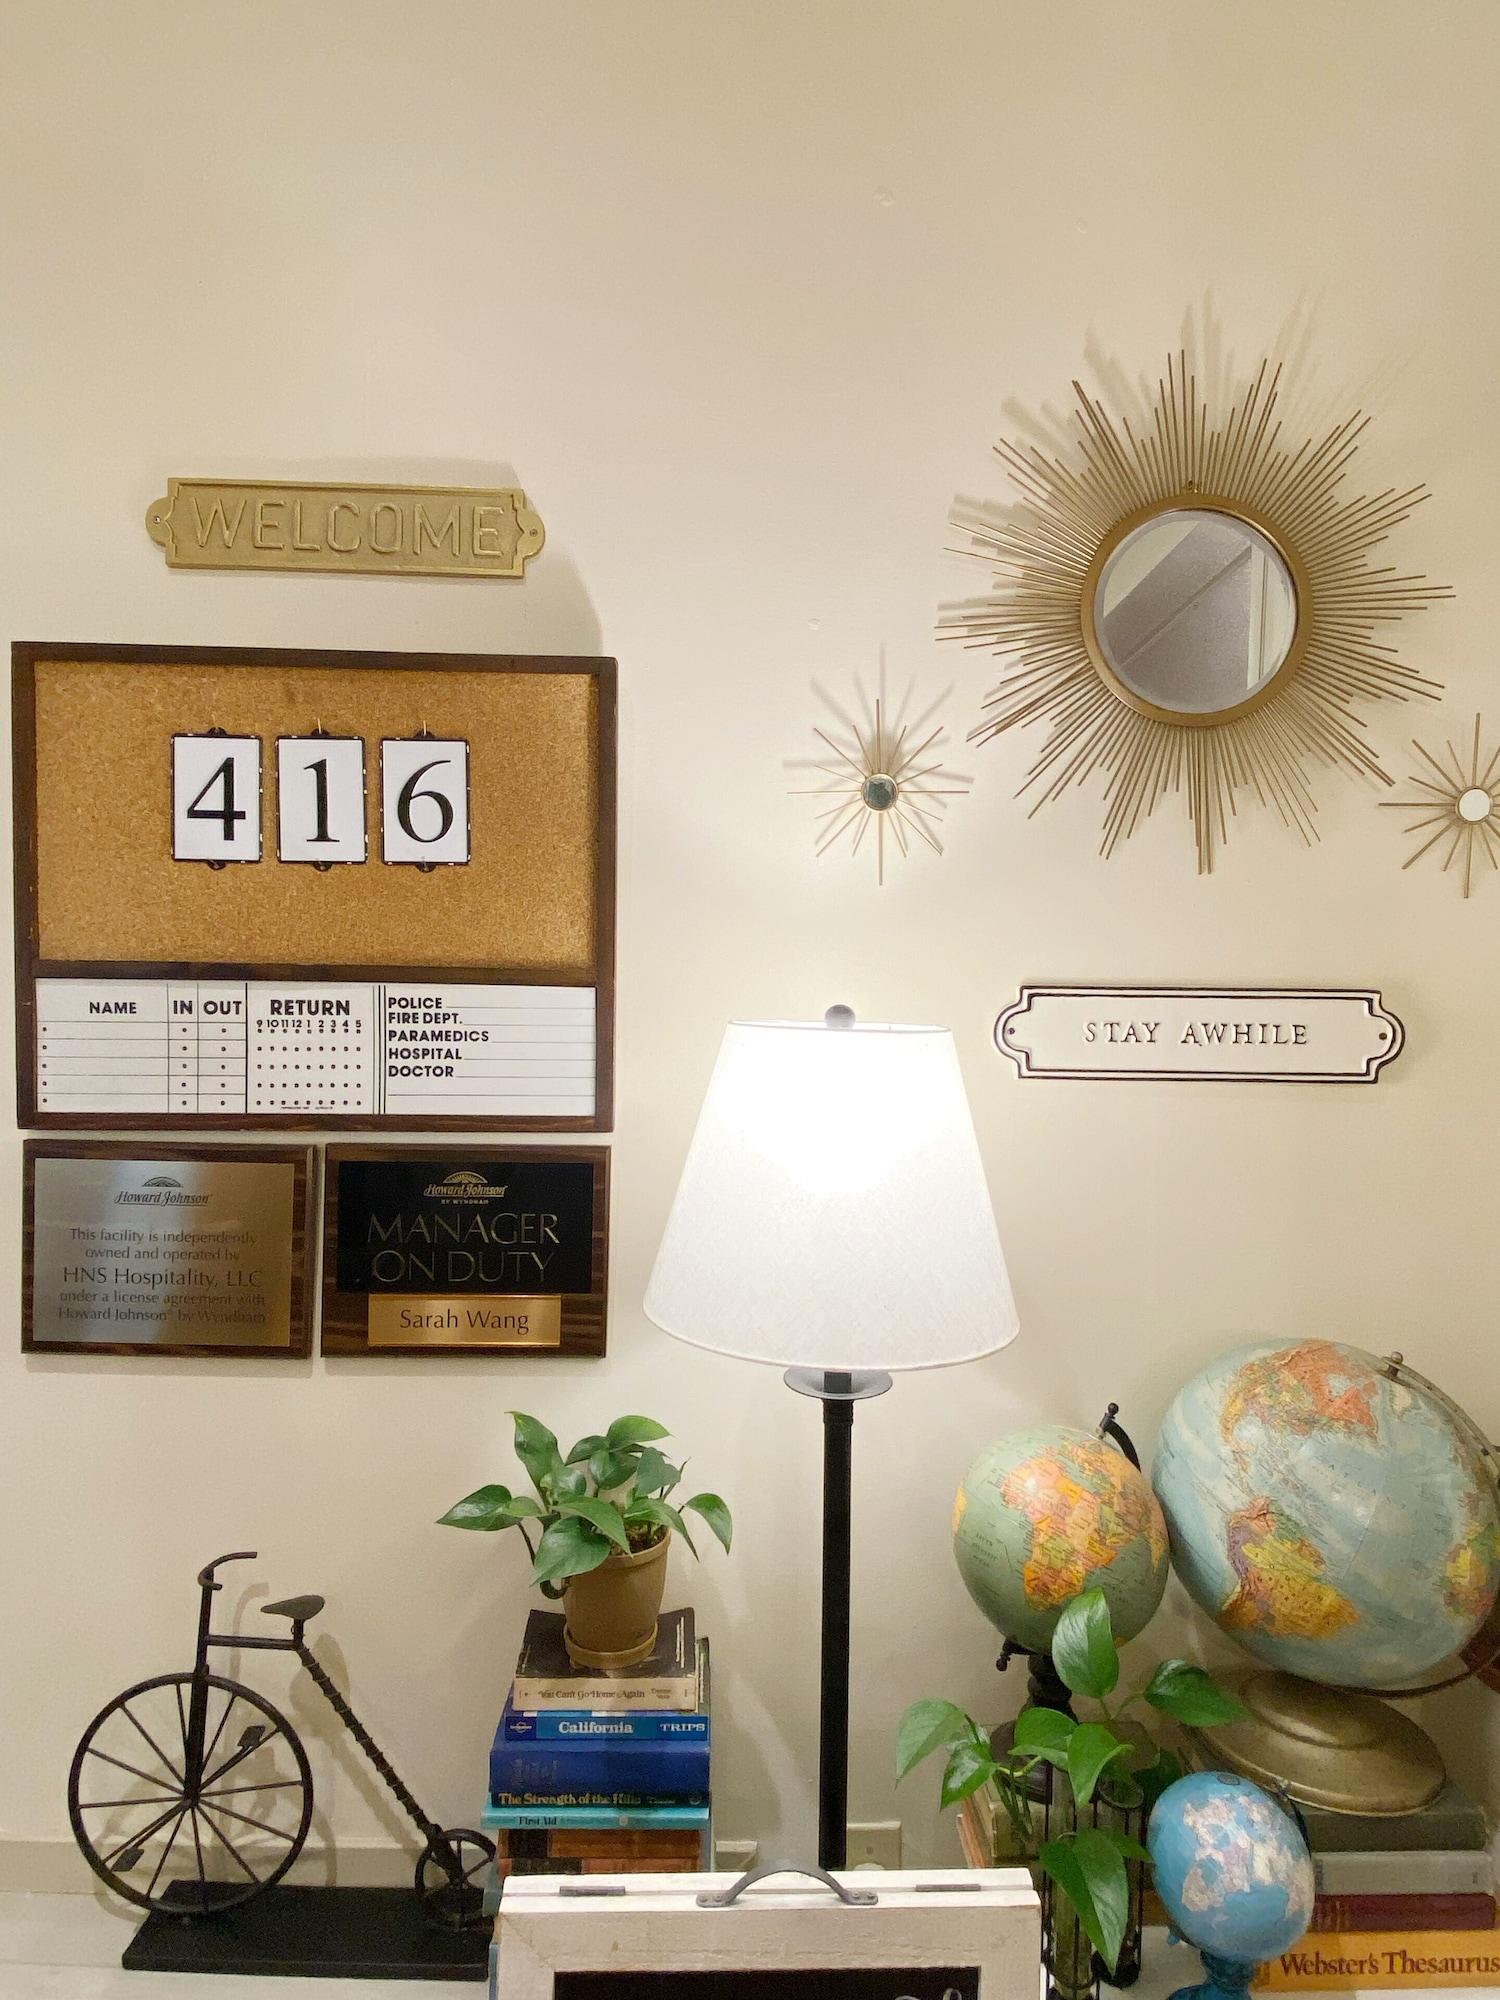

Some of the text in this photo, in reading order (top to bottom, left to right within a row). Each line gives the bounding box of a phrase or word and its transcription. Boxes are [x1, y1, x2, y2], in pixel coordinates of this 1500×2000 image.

[190, 498, 506, 558] WELCOME
[89, 999, 351, 1016] NAME IN OUT RETURN
[388, 996, 443, 1009] POLICE
[256, 1019, 263, 1029] 9
[266, 1019, 279, 1029] 10
[281, 1019, 290, 1029] 11
[292, 1019, 303, 1029] 12
[318, 1019, 325, 1029] 2
[330, 1019, 337, 1029] 3
[342, 1019, 349, 1029] 4
[355, 1019, 362, 1029] 5
[388, 1012, 464, 1025] FIRE DEPT.
[388, 1030, 490, 1042] PARAMEDICS
[1083, 1022, 1308, 1045] STAY AWHILE
[388, 1048, 463, 1060] HOSPITAL
[388, 1065, 454, 1078] DOCTOR
[113, 1190, 210, 1207] Howard Johnson
[423, 1183, 505, 1198] Howard Johnson
[367, 1212, 561, 1245] MANAGER
[70, 1228, 257, 1247] This facility is independently
[84, 1247, 130, 1260] owned
[133, 1247, 159, 1260] and
[162, 1247, 221, 1264] operated
[372, 1250, 555, 1283] ON DUTY
[63, 1266, 263, 1290] HNS Hospitality, LLC
[59, 1288, 98, 1302] under
[102, 1291, 109, 1303] a
[113, 1289, 160, 1304] license
[163, 1292, 232, 1310] agreement
[58, 1306, 112, 1321] Howard
[115, 1307, 168, 1322] Johnson
[399, 1308, 530, 1335] Sarah Wang
[538, 1690, 555, 1699] You
[555, 1690, 576, 1699] Can't
[577, 1690, 590, 1701] Go
[589, 1690, 616, 1699] Home
[617, 1690, 646, 1701] Again
[558, 1721, 634, 1735] California
[660, 1723, 706, 1732] TRIPS
[499, 1792, 522, 1806] The
[523, 1792, 577, 1808] Strength
[577, 1792, 591, 1805] of
[592, 1793, 612, 1805] the
[519, 1816, 541, 1827] First
[1280, 1951, 1379, 1976] Webster's
[1381, 1949, 1500, 1975] Thesaurus
